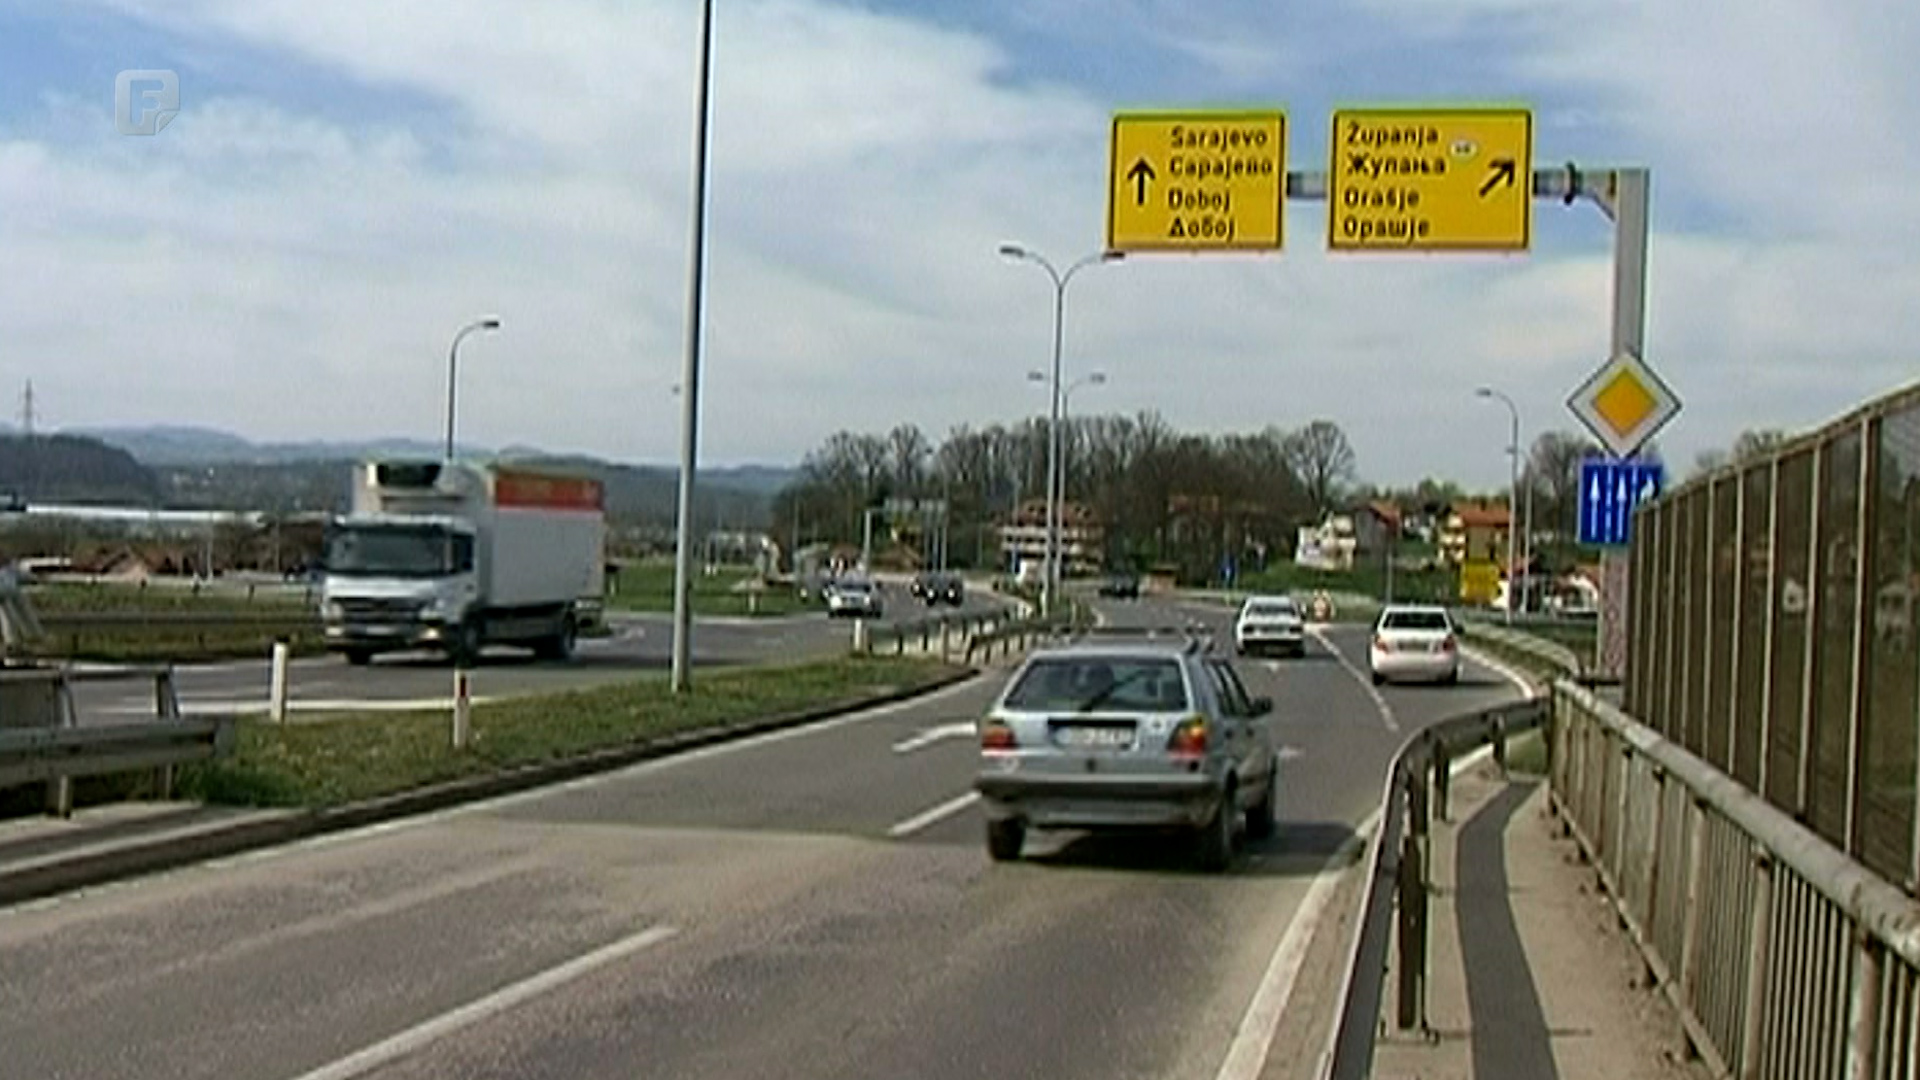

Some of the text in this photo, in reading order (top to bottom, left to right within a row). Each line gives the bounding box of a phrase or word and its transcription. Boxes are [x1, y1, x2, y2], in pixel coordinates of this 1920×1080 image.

[1171, 125, 1268, 152] Sarajevo
[1347, 121, 1439, 148] Županja
[1170, 156, 1273, 180] Сарајево
[1168, 187, 1231, 213] Doboj
[1345, 187, 1420, 212] Orašje
[1168, 216, 1235, 243] Добој
[1344, 215, 1430, 244] Орашје
